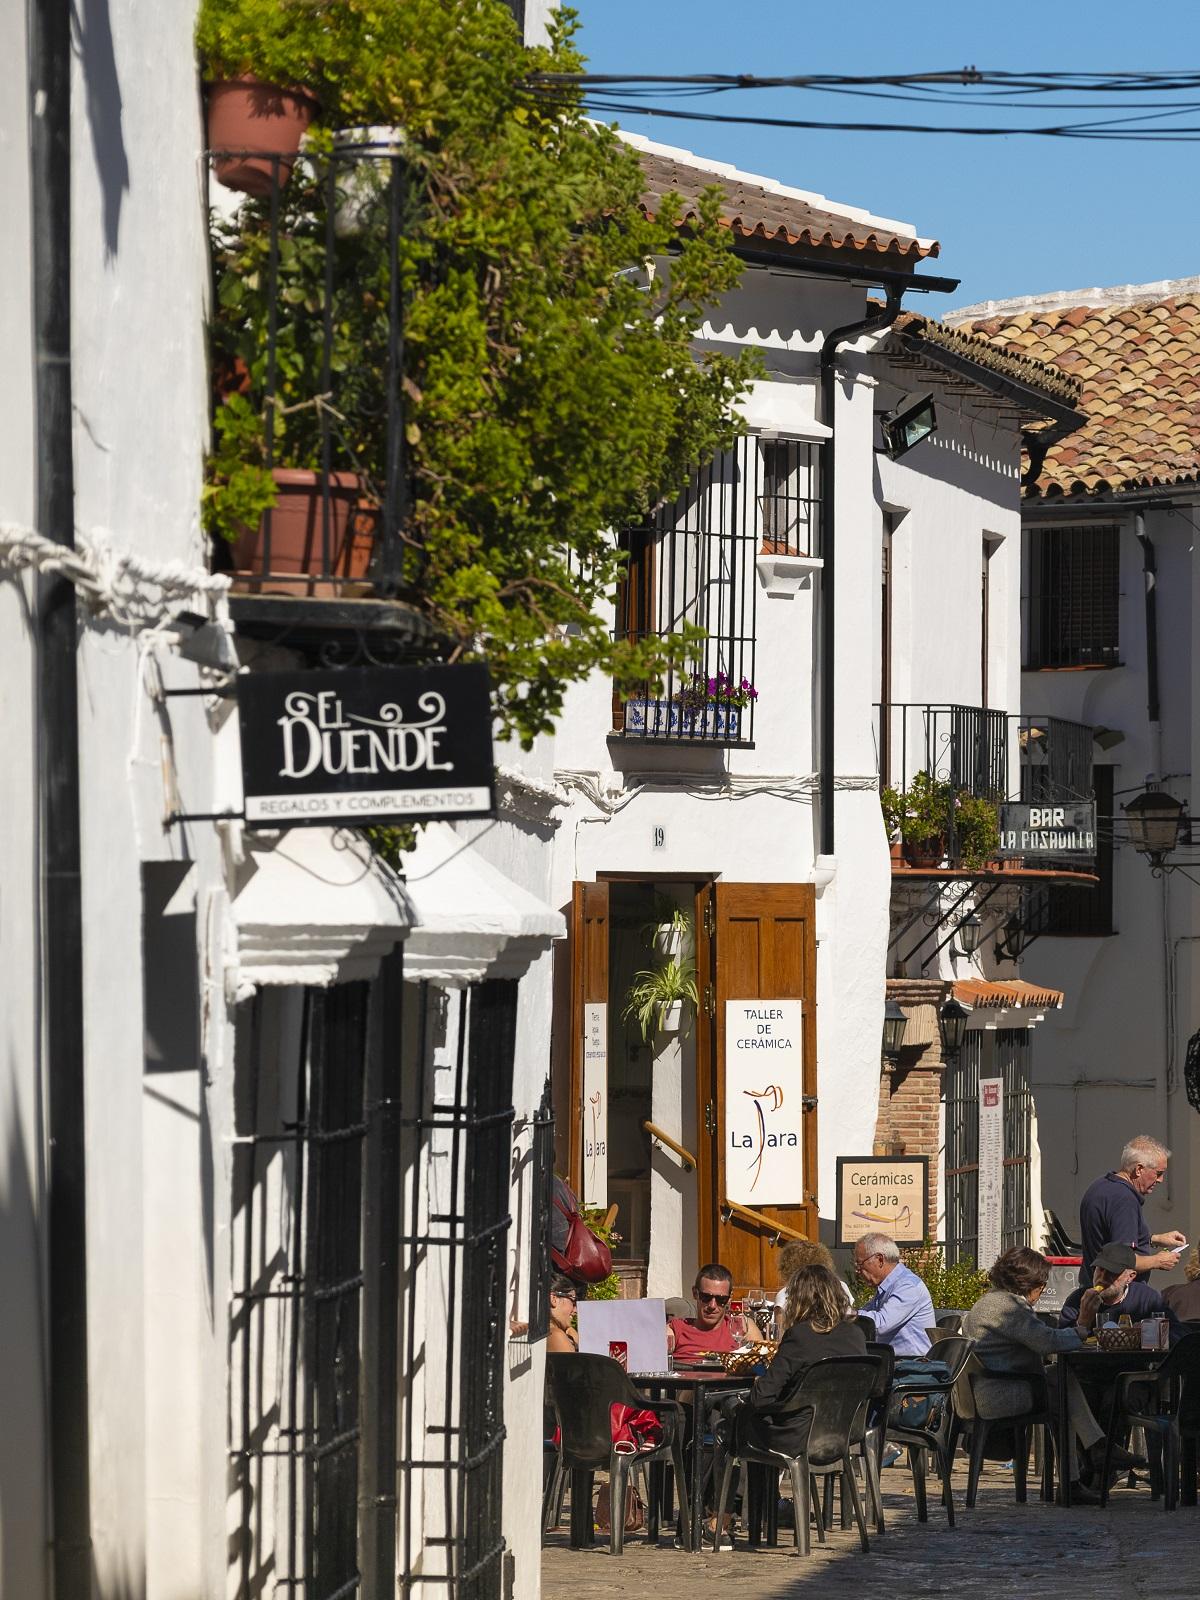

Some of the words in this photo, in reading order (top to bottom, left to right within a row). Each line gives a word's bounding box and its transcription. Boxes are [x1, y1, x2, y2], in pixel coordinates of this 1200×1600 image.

[317, 691, 351, 729] EL
[277, 715, 454, 778] DUENDE
[260, 799, 329, 814] REGALOS
[333, 798, 342, 809] Y
[347, 793, 474, 810] COMPLEMENTOS
[1029, 808, 1065, 827] BAR
[654, 827, 664, 846] 19
[1000, 831, 1016, 849] LA
[744, 1009, 783, 1019] TALLER
[757, 1025, 771, 1034] DE
[737, 1037, 792, 1049] CERÁMICA
[731, 1131, 753, 1148] La
[851, 1171, 914, 1185] Cerámicas
[859, 1193, 872, 1206] La
[874, 1193, 899, 1208] Jara
